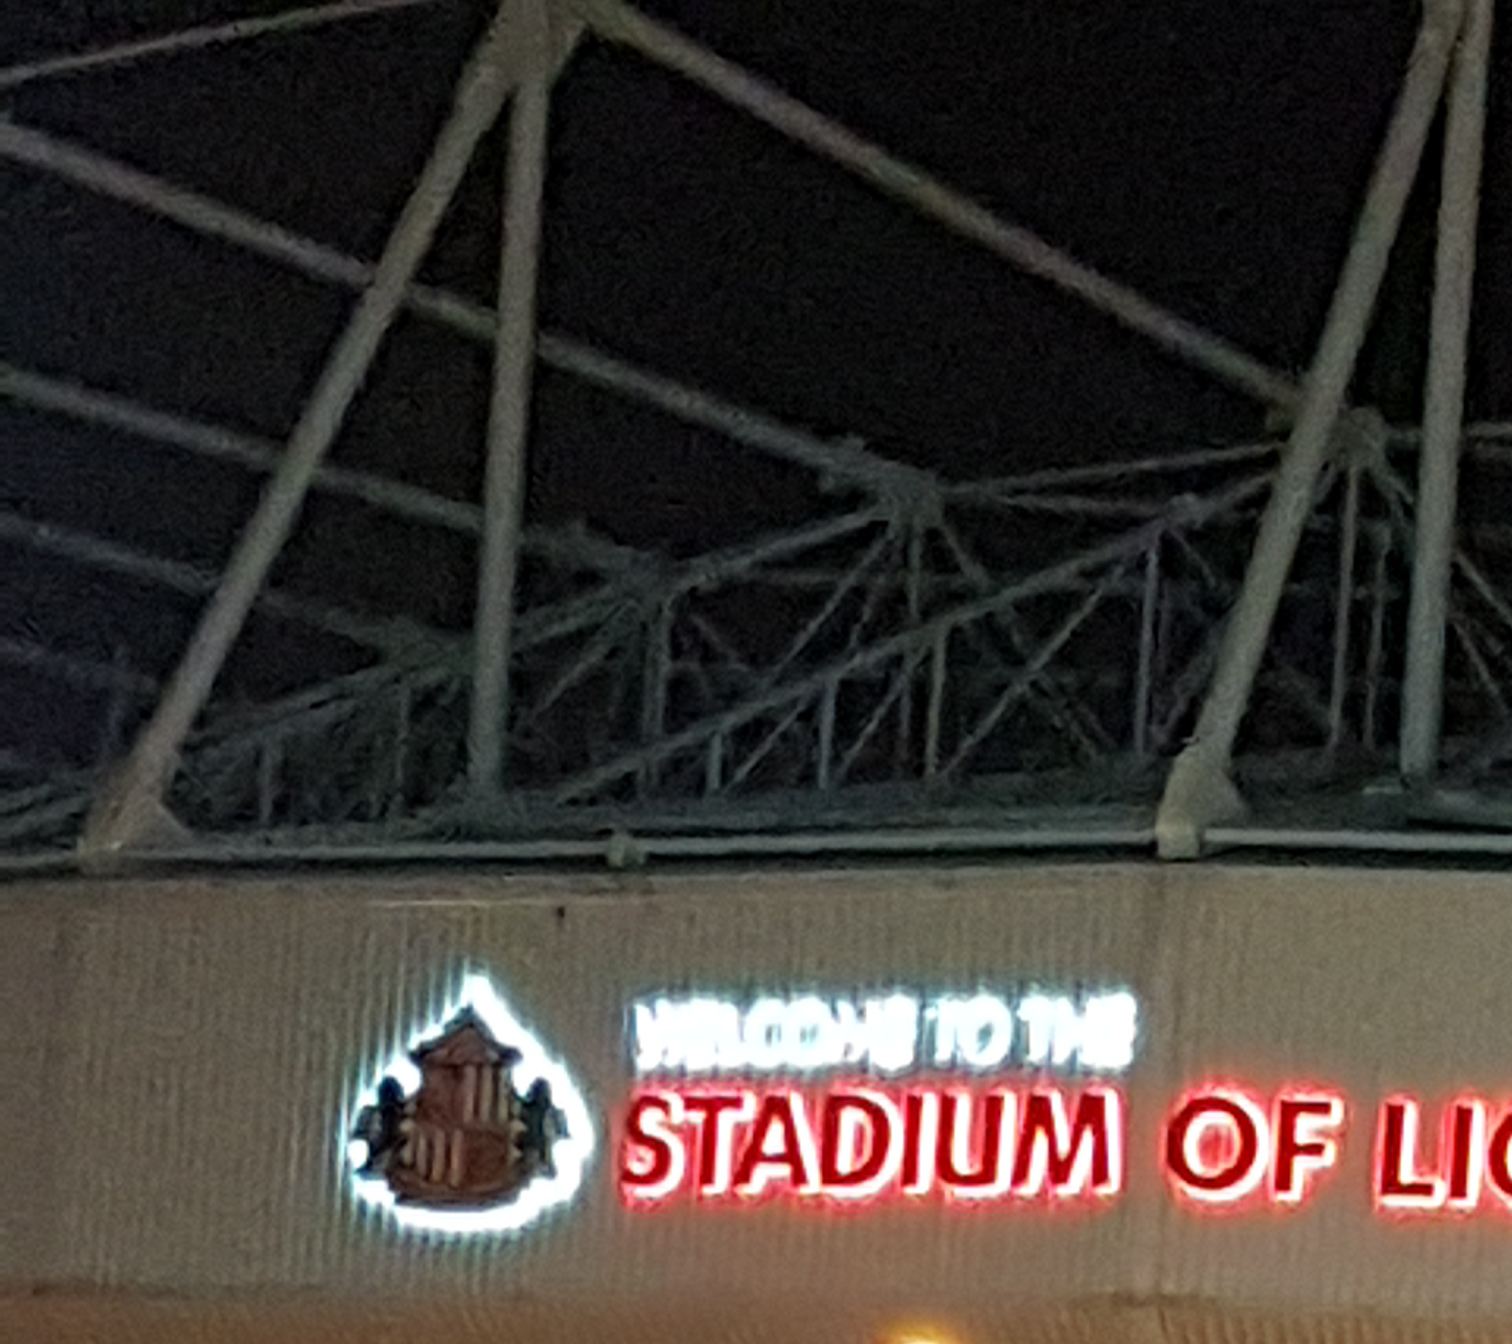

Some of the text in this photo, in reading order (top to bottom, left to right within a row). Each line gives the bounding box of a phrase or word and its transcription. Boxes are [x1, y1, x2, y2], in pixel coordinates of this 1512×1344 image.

[926, 993, 1011, 1067] TO
[1016, 993, 1137, 1068] THE
[621, 1090, 1120, 1200] STADIUM
[1165, 1089, 1348, 1204] OF
